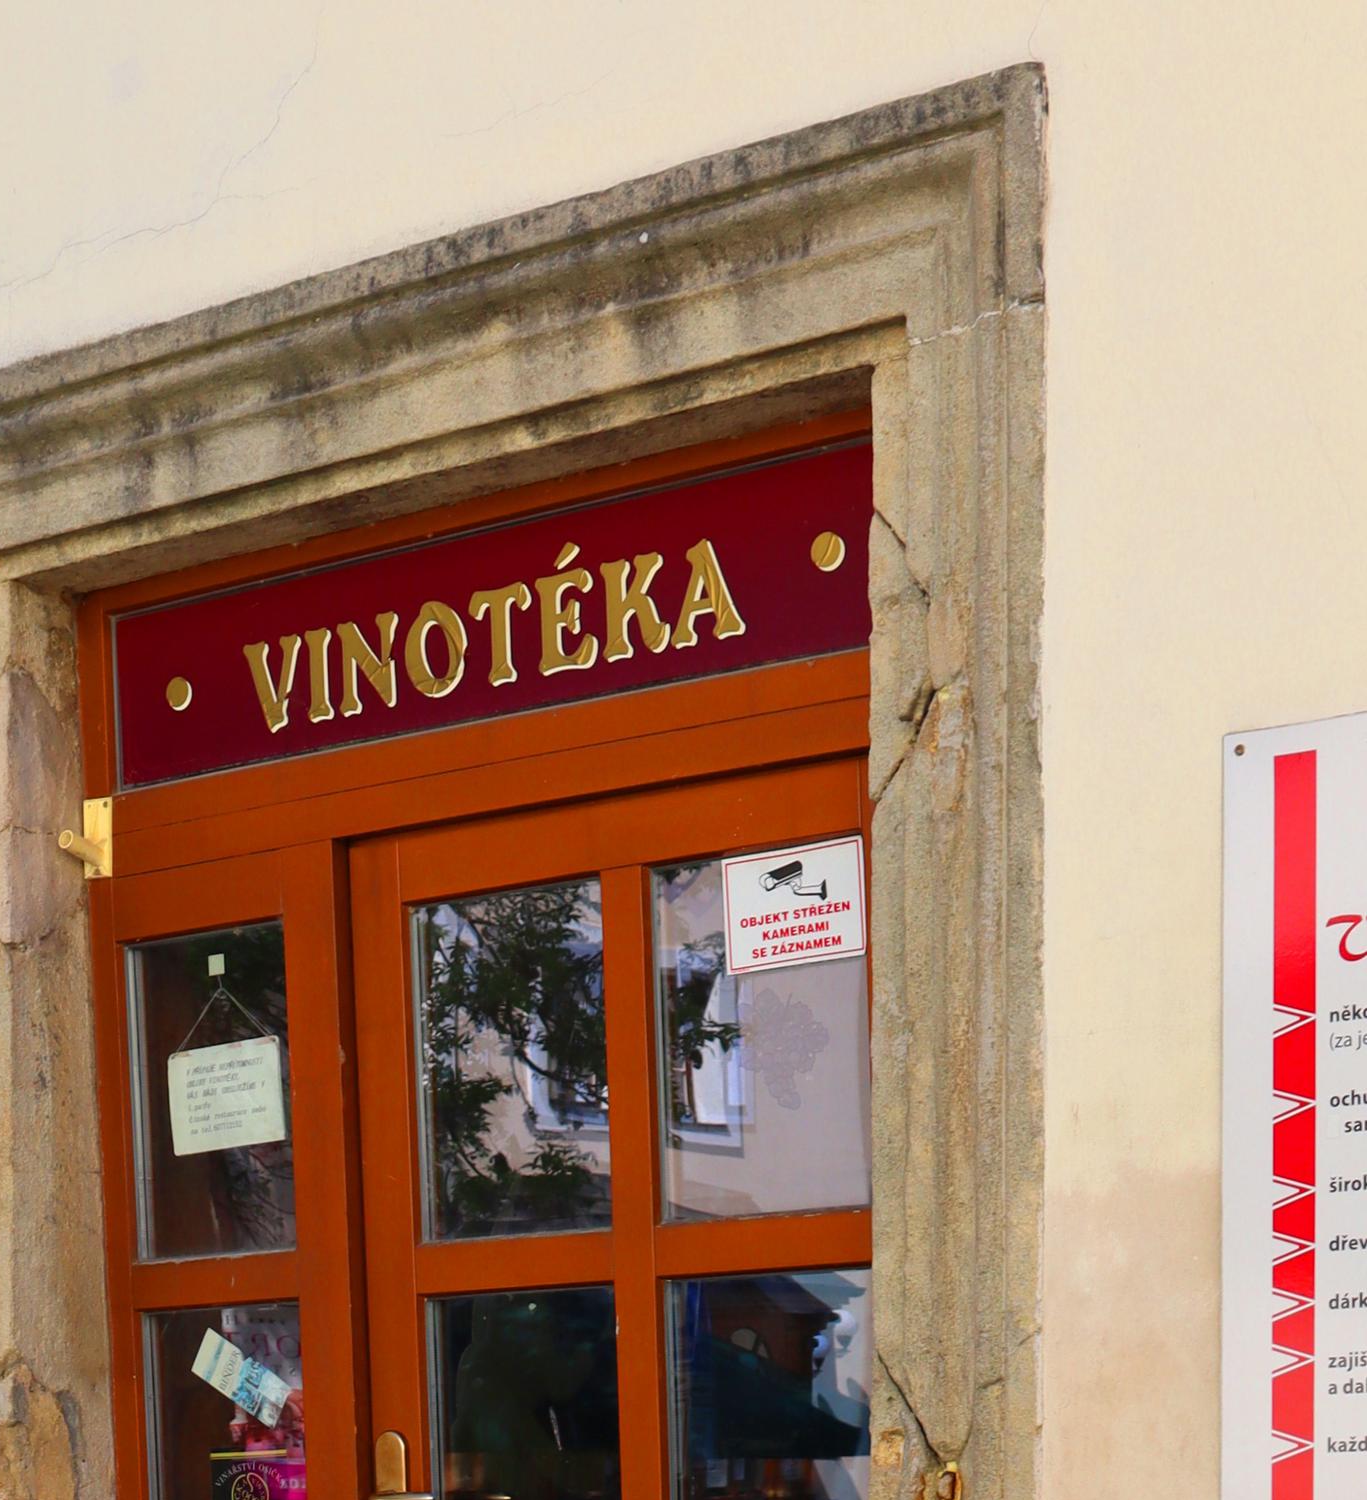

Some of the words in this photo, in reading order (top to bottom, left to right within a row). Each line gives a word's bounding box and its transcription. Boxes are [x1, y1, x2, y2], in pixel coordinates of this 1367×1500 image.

[242, 538, 747, 734] VINOTÉKA
[739, 910, 790, 929] OBJEKT
[792, 900, 852, 920] STŘEŽEN
[761, 920, 830, 942] KAMERAMI
[751, 946, 768, 960] SE
[770, 935, 843, 956] ZÁZNAMEM
[1344, 1119, 1367, 1133] sa
[1328, 1235, 1367, 1252] dřev
[1328, 1291, 1367, 1310] dárk
[1328, 1351, 1367, 1372] zajiš
[1328, 1383, 1337, 1395] a
[1327, 1435, 1367, 1453] každ
